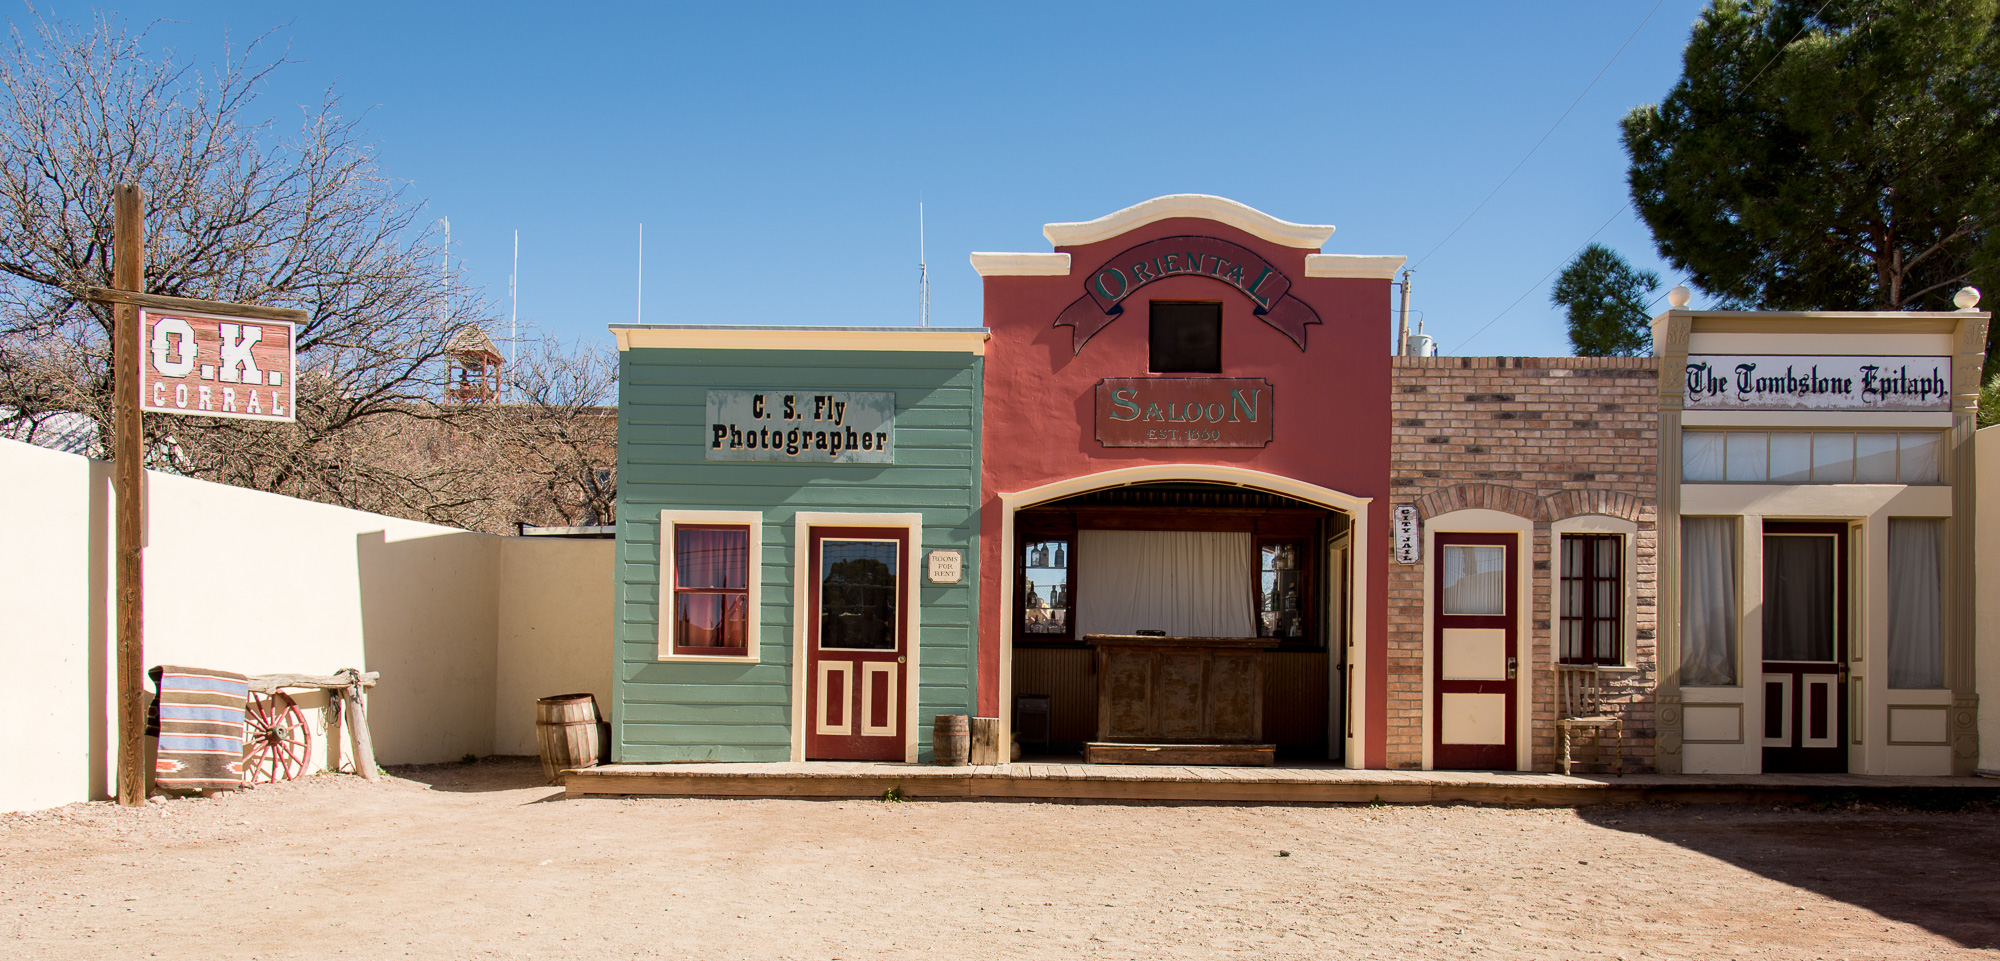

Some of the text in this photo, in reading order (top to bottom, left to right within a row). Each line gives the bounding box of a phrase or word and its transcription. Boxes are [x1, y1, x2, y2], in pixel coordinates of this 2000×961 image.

[1094, 252, 1273, 310] ORIENTAL
[150, 317, 282, 386] O.K.
[153, 381, 284, 415] CORRAL
[1685, 362, 1949, 403] The Tombstone Epitaph.
[752, 394, 847, 427] C. S. Fly
[712, 423, 889, 457] Photographer
[1147, 428, 1181, 440] EST.
[1401, 509, 1412, 561] CITY JAIL
